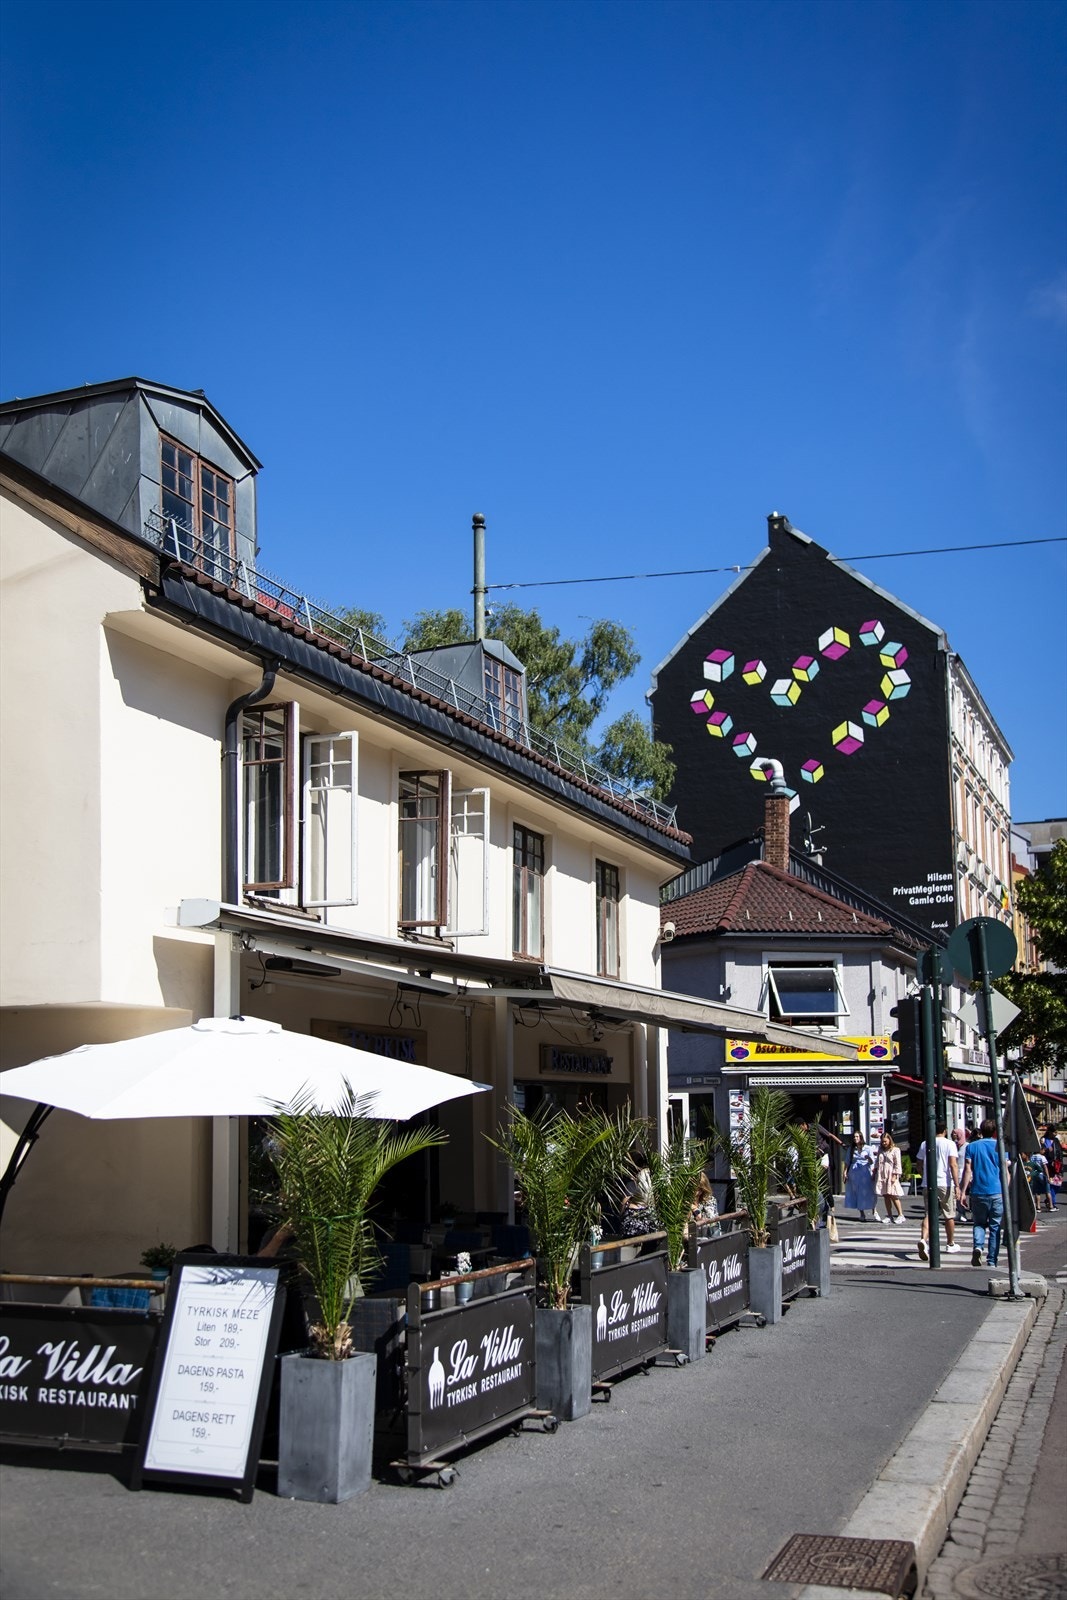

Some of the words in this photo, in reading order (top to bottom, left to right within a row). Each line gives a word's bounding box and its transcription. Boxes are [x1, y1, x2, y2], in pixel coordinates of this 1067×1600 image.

[927, 873, 953, 882] Hilsen
[893, 884, 953, 895] PrivatMegleren
[909, 896, 935, 905] Gamle
[936, 894, 954, 903] Oslo
[708, 1260, 722, 1289] La
[722, 1253, 743, 1282] Villa
[608, 1289, 630, 1325] La
[631, 1281, 662, 1316] Villa
[187, 1305, 229, 1318] TYRKISK
[231, 1308, 260, 1320] MEZE
[196, 1321, 216, 1332] Liten
[608, 1324, 629, 1342] TYRKISK
[631, 1312, 660, 1333] RESTAURANT
[194, 1336, 211, 1346] Stor
[36, 1340, 144, 1386] Villa
[446, 1339, 479, 1386] La
[480, 1324, 524, 1371] Villa
[177, 1364, 215, 1377] DAGENS
[216, 1367, 245, 1379] PASTA
[446, 1382, 478, 1408] TYRKISK
[480, 1363, 523, 1392] RESTAURANT
[38, 1387, 138, 1410] RESTAURANT
[172, 1409, 210, 1423] DAGENS
[211, 1412, 236, 1425] RETT
